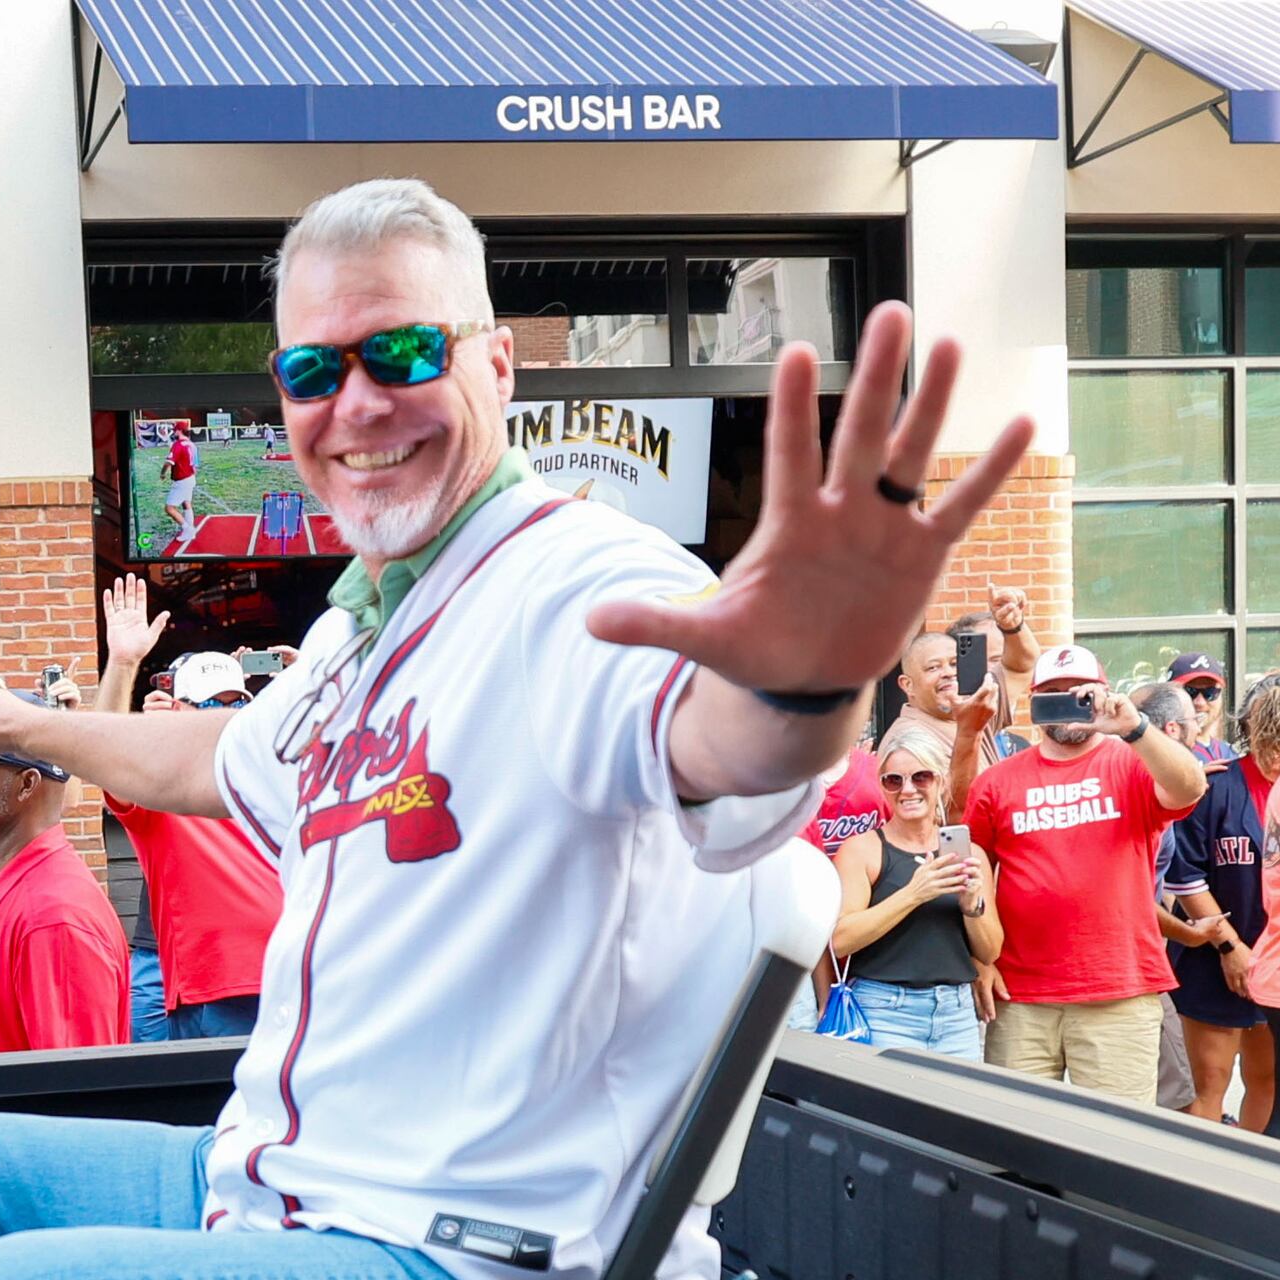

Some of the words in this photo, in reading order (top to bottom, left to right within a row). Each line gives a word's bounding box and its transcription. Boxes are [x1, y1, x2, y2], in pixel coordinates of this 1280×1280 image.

[496, 95, 633, 132] CRUSH
[643, 94, 722, 130] BAR
[506, 404, 555, 453] IM
[561, 399, 672, 482] BEAM
[530, 453, 565, 476] OUD
[569, 452, 639, 486] PARTNER
[1025, 777, 1102, 808] DUBS
[1011, 796, 1122, 835] BASEBALL
